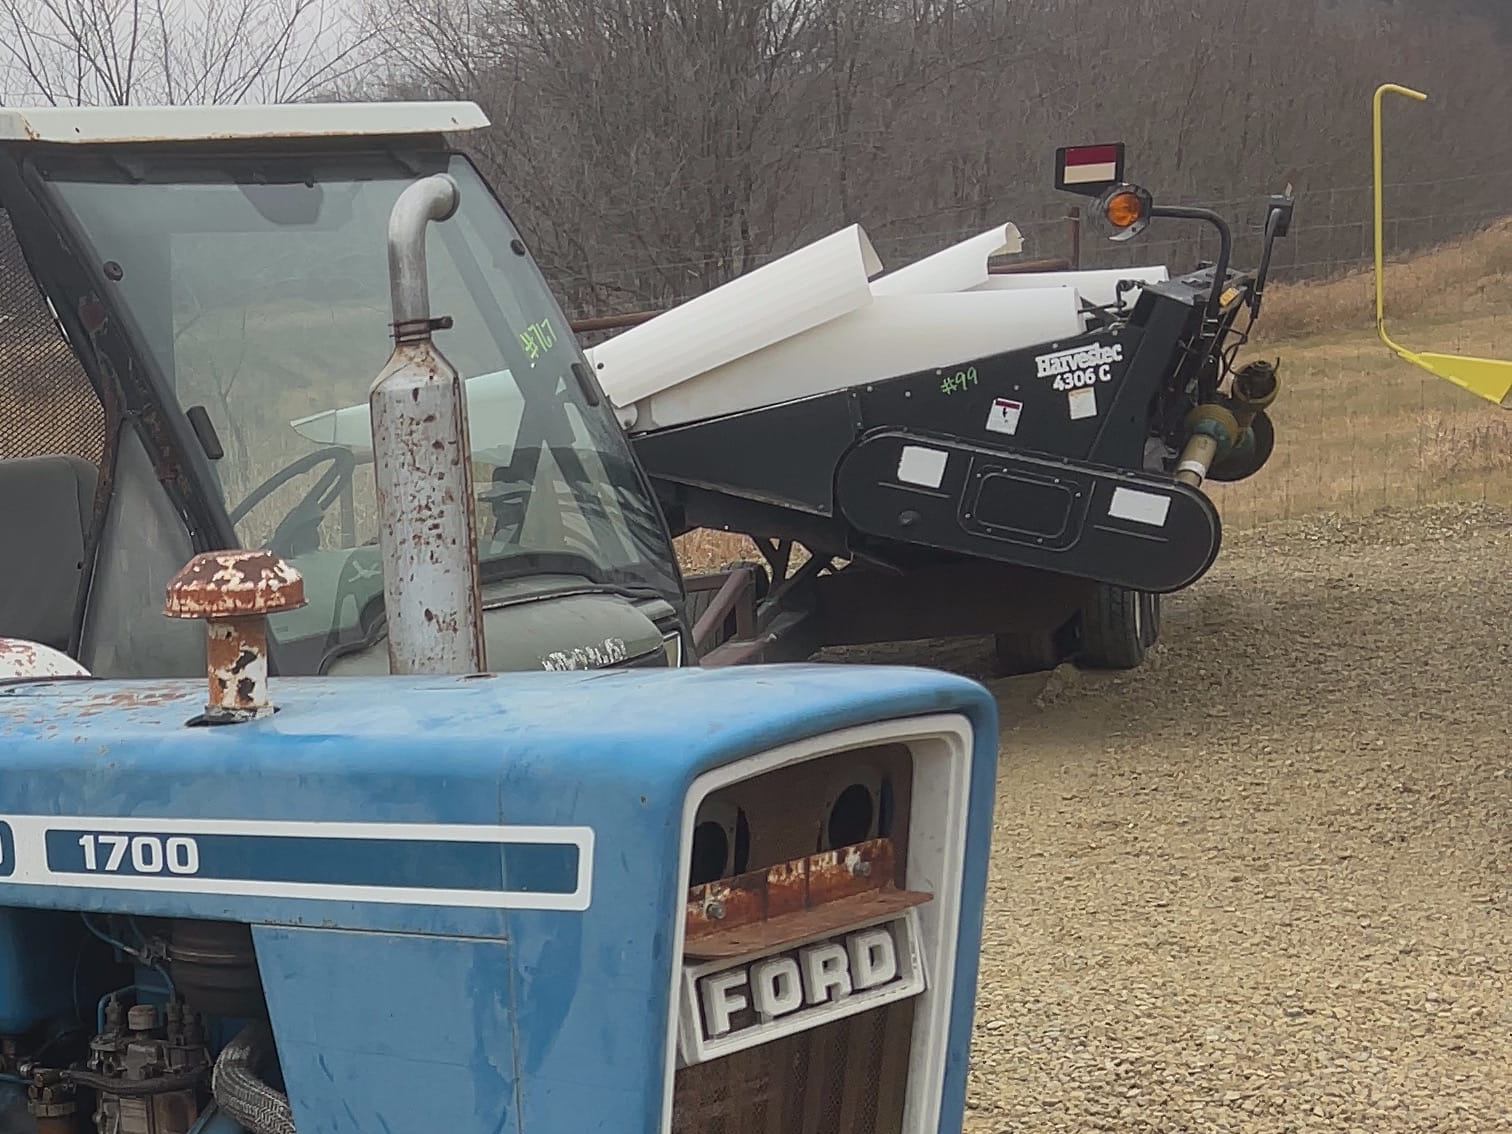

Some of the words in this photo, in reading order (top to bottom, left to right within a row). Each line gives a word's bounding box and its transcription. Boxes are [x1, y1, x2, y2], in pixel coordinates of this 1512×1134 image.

[940, 367, 979, 395] #99
[1053, 367, 1096, 391] 4306
[1099, 364, 1111, 382] C
[78, 834, 200, 875] 1700
[702, 927, 898, 1038] FORD
